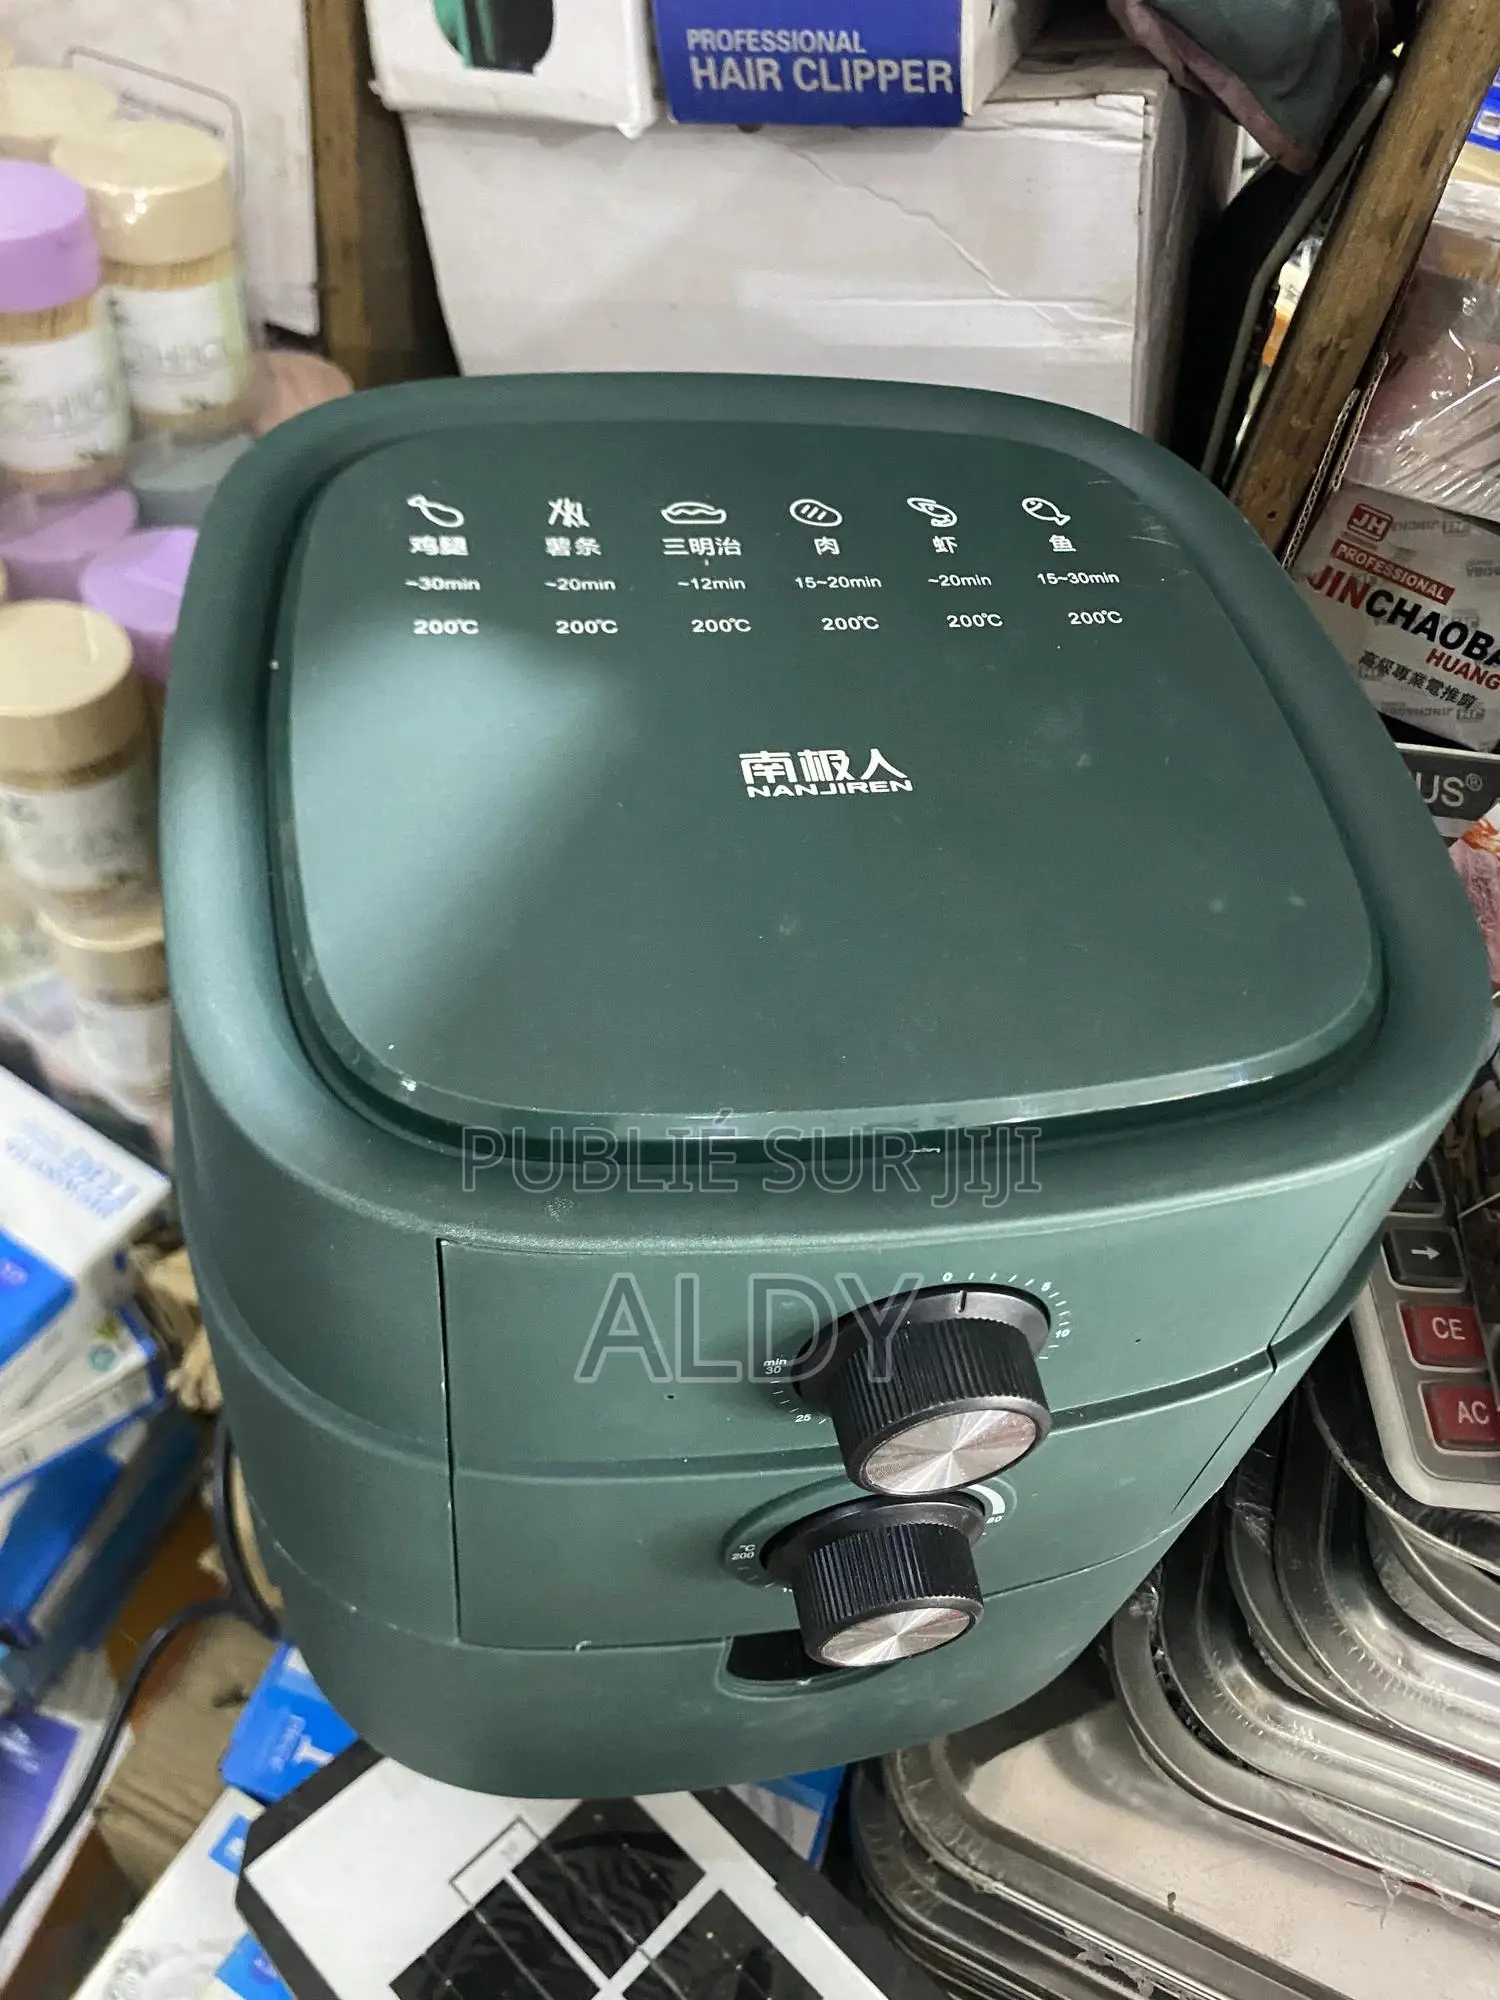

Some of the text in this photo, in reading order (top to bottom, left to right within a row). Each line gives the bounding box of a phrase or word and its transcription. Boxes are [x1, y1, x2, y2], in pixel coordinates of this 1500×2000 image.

[686, 28, 867, 54] PROFESSIONAL
[689, 56, 954, 94] HAIR CLIPPER
[1352, 511, 1389, 535] JH
[544, 536, 602, 556] 薯条
[661, 536, 742, 556] 三明治
[813, 536, 841, 555] 肉
[931, 535, 958, 554] 虾
[1048, 534, 1077, 552] 鱼
[405, 571, 1120, 591] ~30min ~20min ~12min 15~20min ~20min 15~30min
[1335, 542, 1445, 601] PROFESSIONAL
[739, 748, 908, 785] 南极人
[747, 780, 914, 798] NANJIREN
[1055, 1328, 1071, 1339] 10
[1431, 1316, 1467, 1340] CE
[763, 1357, 788, 1367] min
[765, 1365, 782, 1375] 30
[794, 1413, 812, 1423] 25
[1457, 1400, 1490, 1425] AC
[731, 1551, 755, 1560] 200
